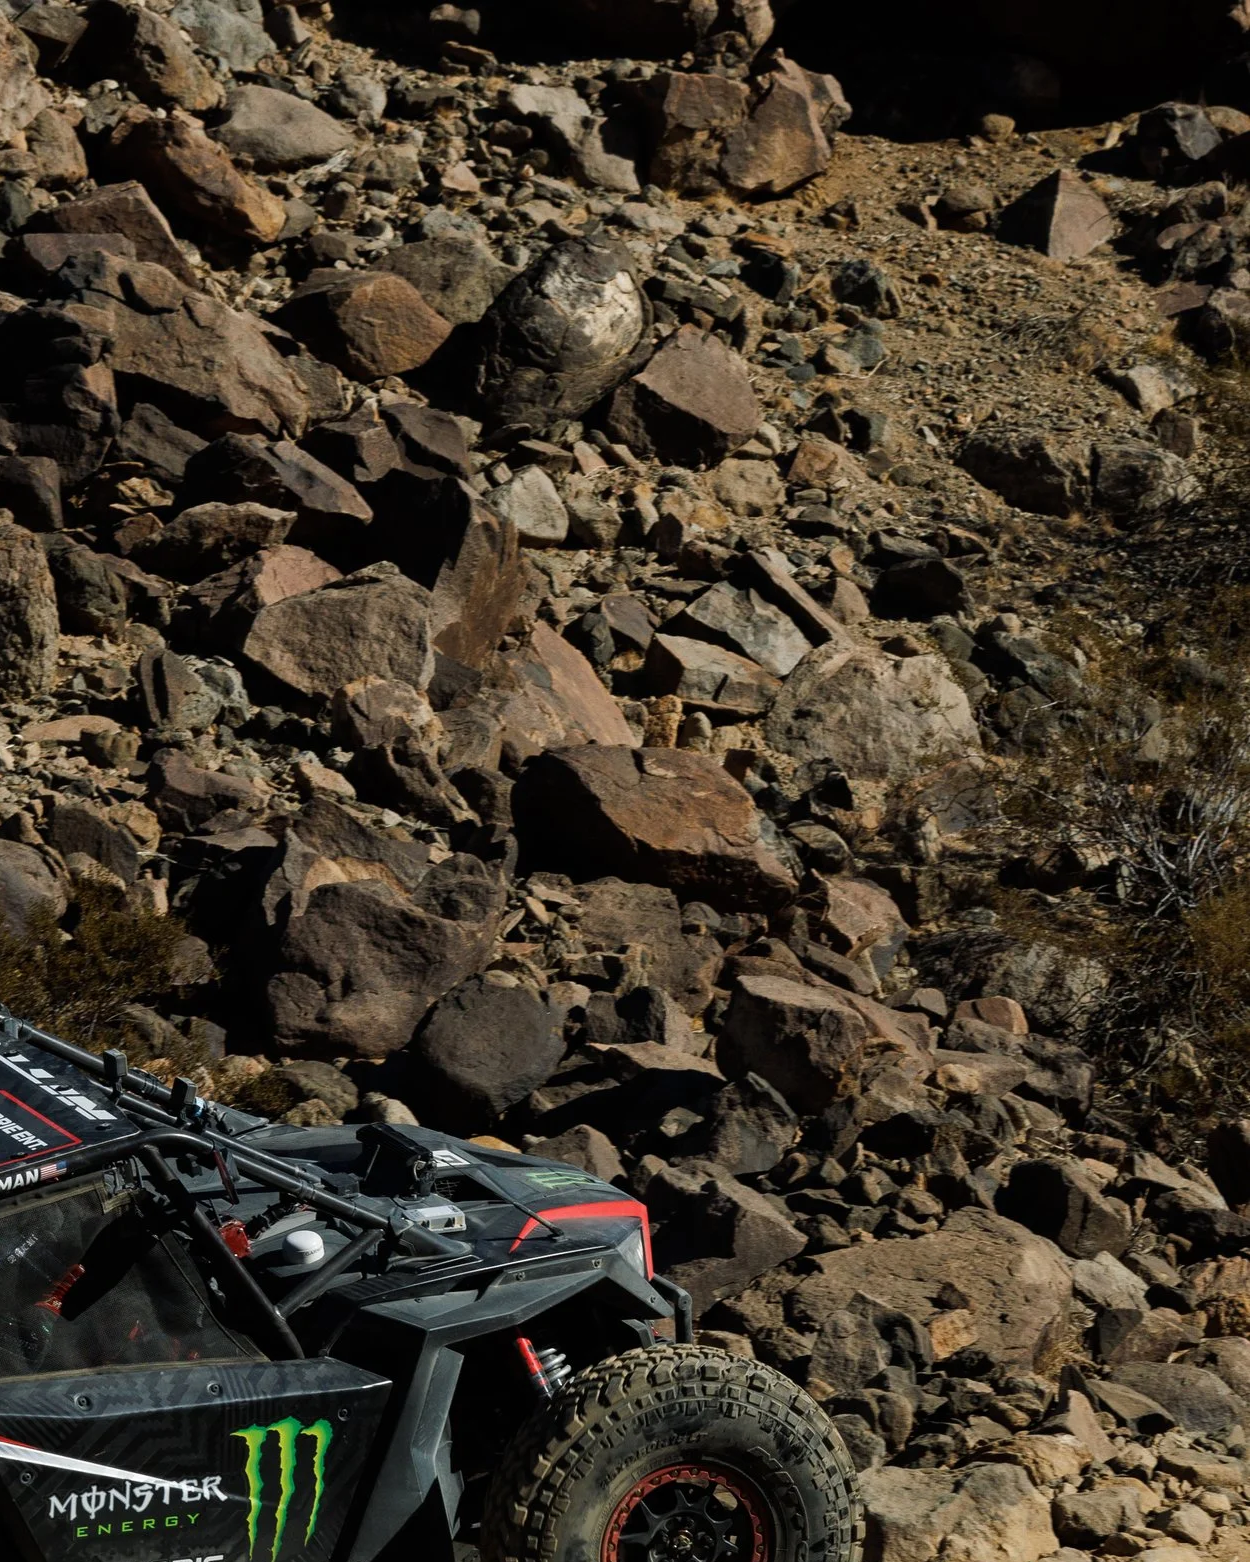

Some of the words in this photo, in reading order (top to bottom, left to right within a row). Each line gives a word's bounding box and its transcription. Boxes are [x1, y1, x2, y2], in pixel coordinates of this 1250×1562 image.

[12, 1130, 48, 1151] ENT.
[49, 1475, 228, 1520] MONSTER
[76, 1513, 201, 1538] ENERGY
